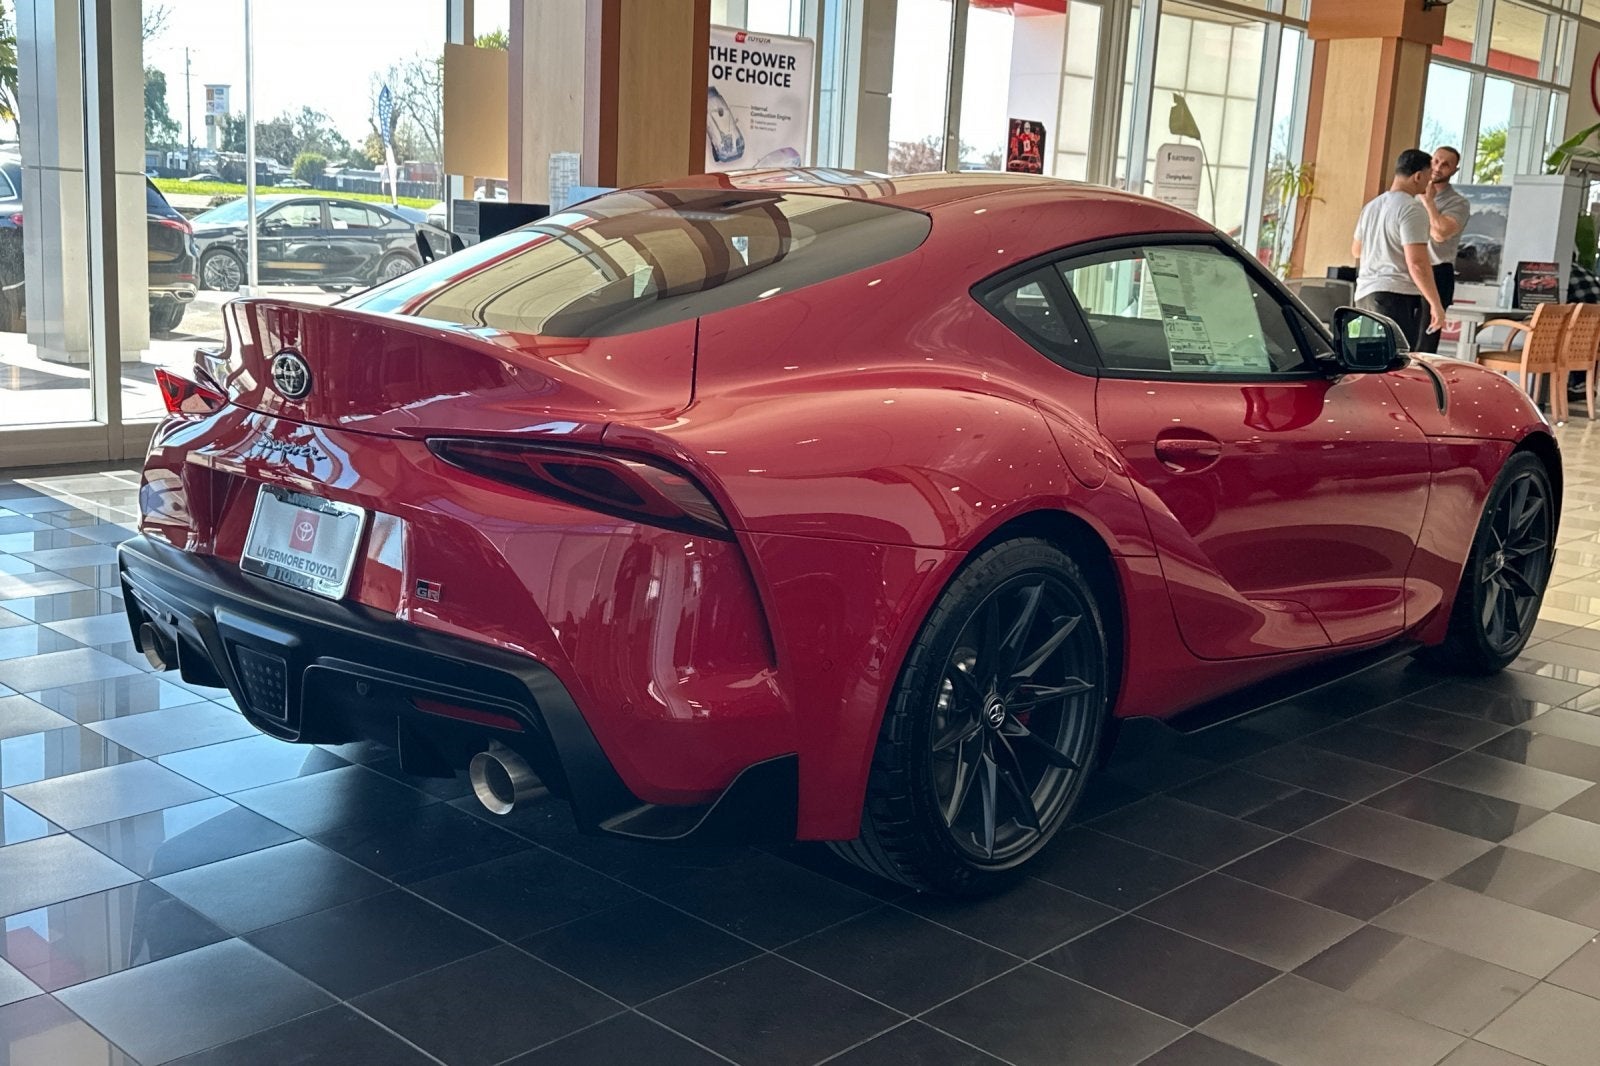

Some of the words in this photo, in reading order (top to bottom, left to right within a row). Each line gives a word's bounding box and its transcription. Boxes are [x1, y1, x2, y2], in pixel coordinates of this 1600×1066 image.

[747, 36, 771, 44] TOYOTA
[709, 46, 738, 63] THE
[741, 50, 796, 71] POWER
[712, 65, 733, 81] OF
[735, 68, 792, 88] CHOICE
[256, 546, 305, 570] LIVERMORE
[305, 560, 339, 579] TOYOTA
[416, 586, 440, 601] GR
